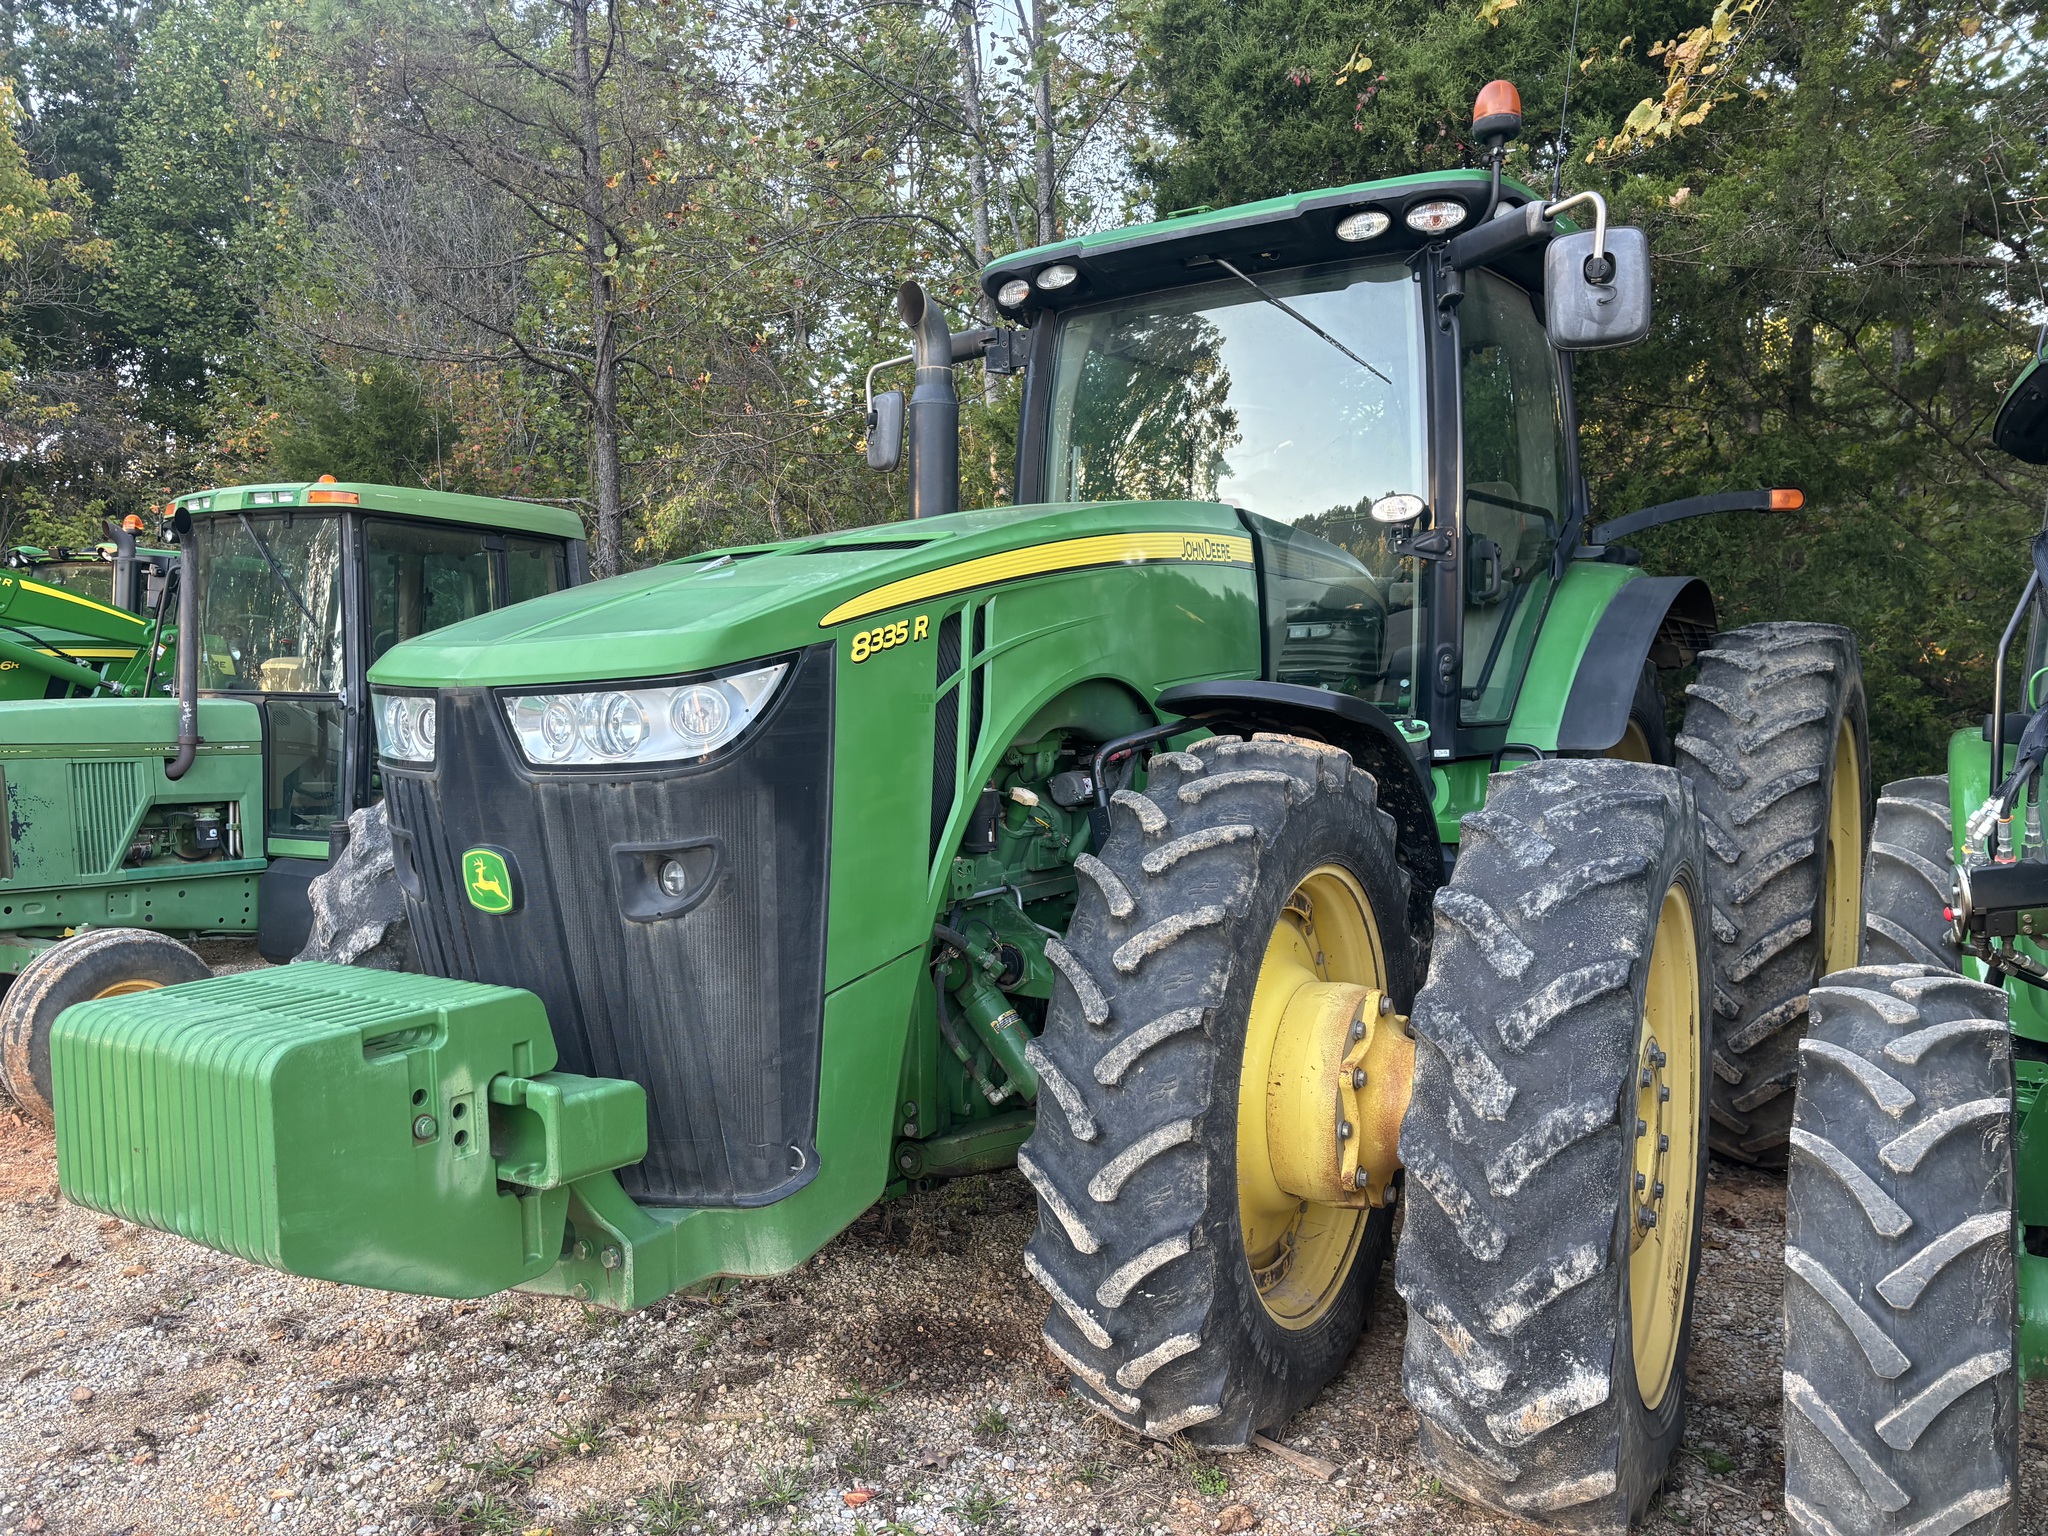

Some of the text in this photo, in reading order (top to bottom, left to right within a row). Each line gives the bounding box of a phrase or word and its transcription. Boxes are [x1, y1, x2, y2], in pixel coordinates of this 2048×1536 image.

[1181, 537, 1232, 561] JOHN DEERE
[851, 614, 929, 664] 8335 R
